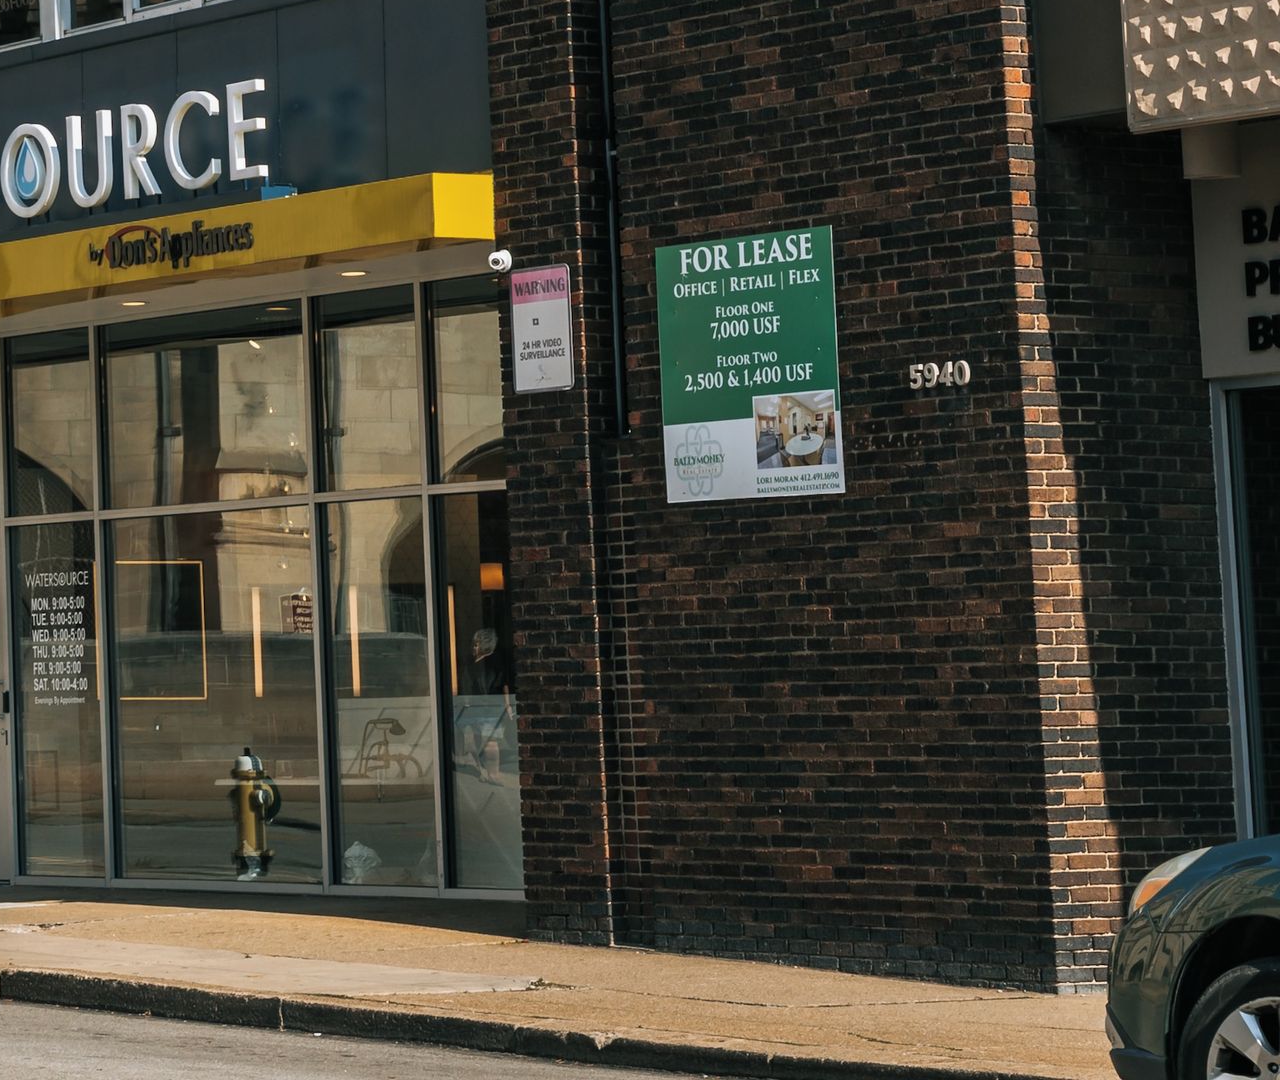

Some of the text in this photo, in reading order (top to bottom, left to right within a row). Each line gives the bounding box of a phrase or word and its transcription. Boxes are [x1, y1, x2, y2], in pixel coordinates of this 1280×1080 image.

[89, 220, 255, 270] by Don's Appliances
[679, 232, 813, 275] FOR LEASE
[514, 277, 566, 297] WARNING
[710, 316, 781, 341] 7,000 USF
[522, 338, 562, 350] 24 HR VIDEO
[520, 347, 566, 361] SURVEILLANCE
[684, 363, 813, 393] 2,500 & 1,400 USF
[909, 359, 971, 390] 5940
[673, 454, 725, 467] BALLYMONEY
[757, 471, 840, 485] LORI MORAN 412.491.1690
[25, 571, 89, 588] WATERSOURCE
[31, 596, 85, 611] MON. 9:00-5:00
[31, 612, 83, 626] TUE. 9:00-5:00
[31, 628, 86, 642] WED. 9:00-5:00
[32, 644, 84, 658] THU. 9:00-5:00
[33, 661, 82, 675] FRI. 9:00-5:00
[33, 677, 88, 691] SAT. 10:00-4:00
[53, 696, 60, 706] By
